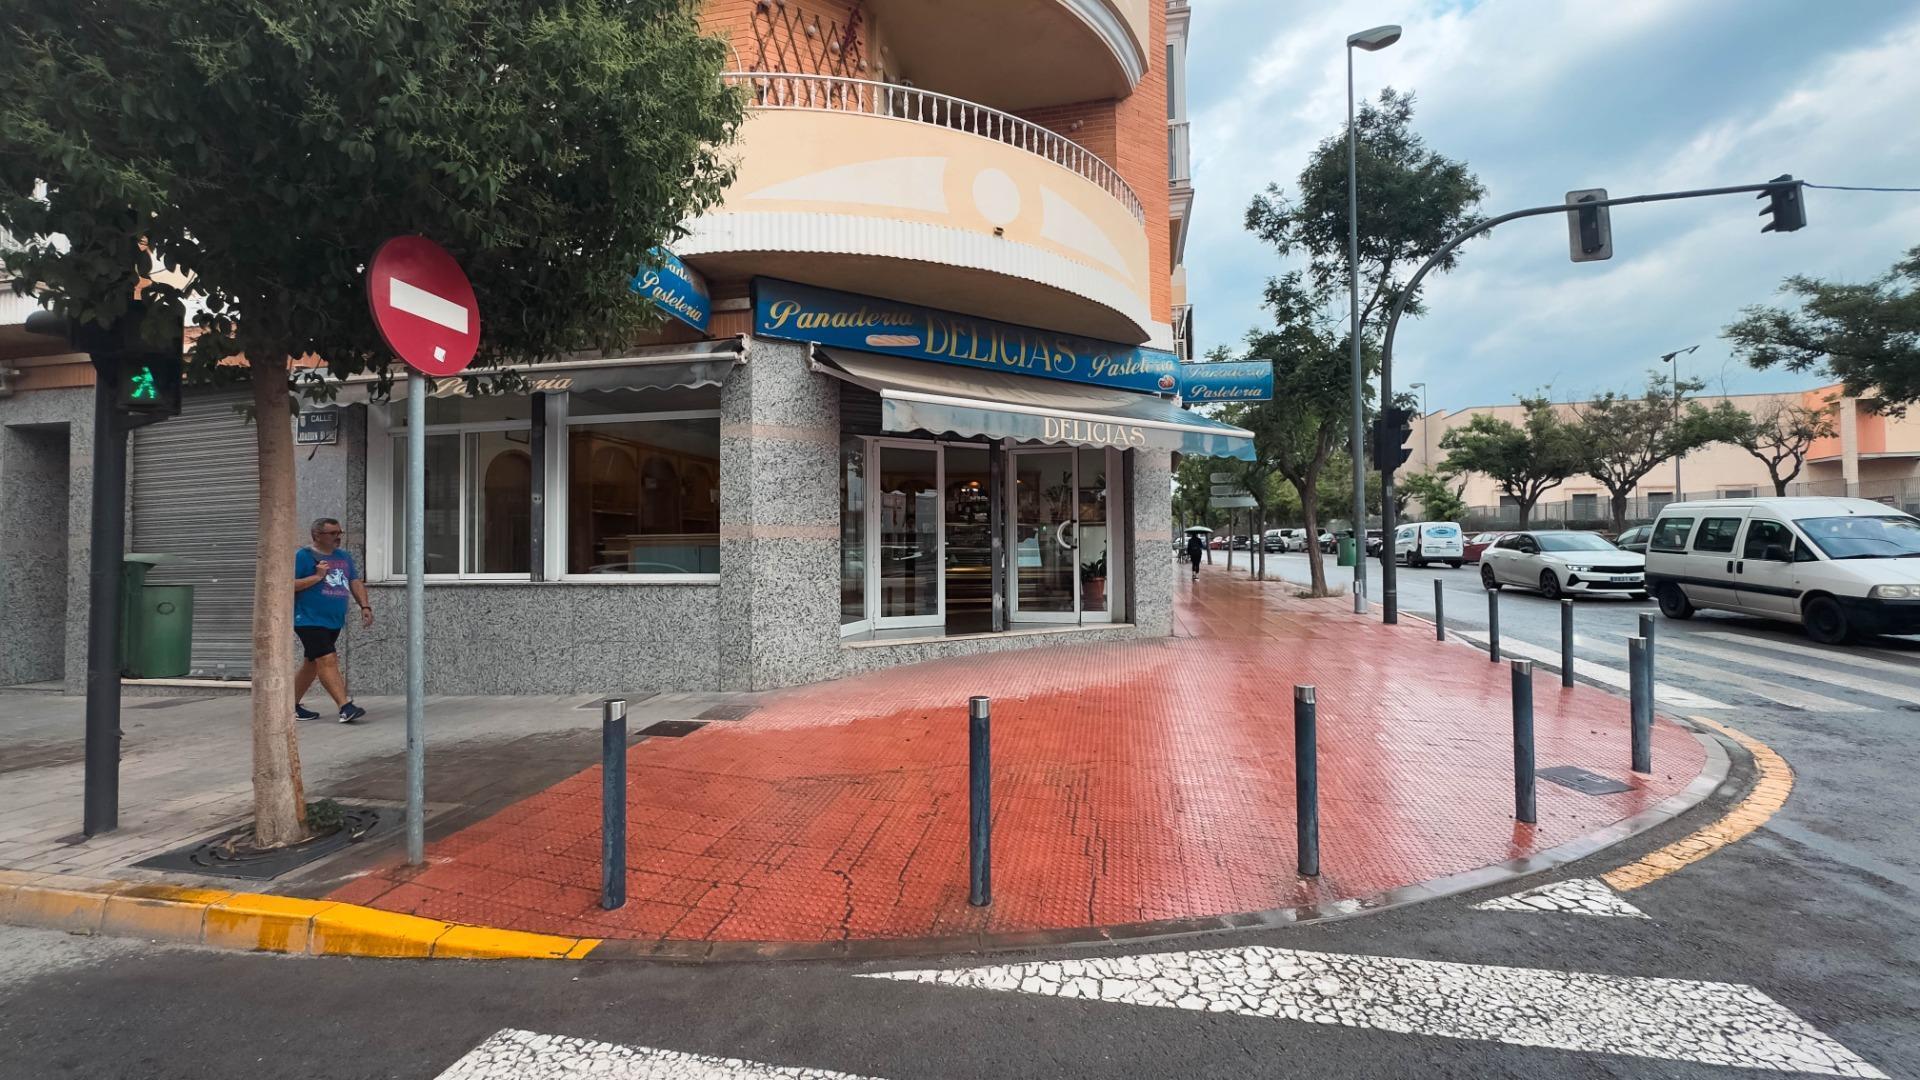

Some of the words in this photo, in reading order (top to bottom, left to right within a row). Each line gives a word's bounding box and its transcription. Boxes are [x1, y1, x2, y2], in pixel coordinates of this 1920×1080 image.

[924, 314, 1077, 374] DELICIAS
[310, 413, 334, 423] CALLE
[1043, 417, 1146, 446] DELICIAS
